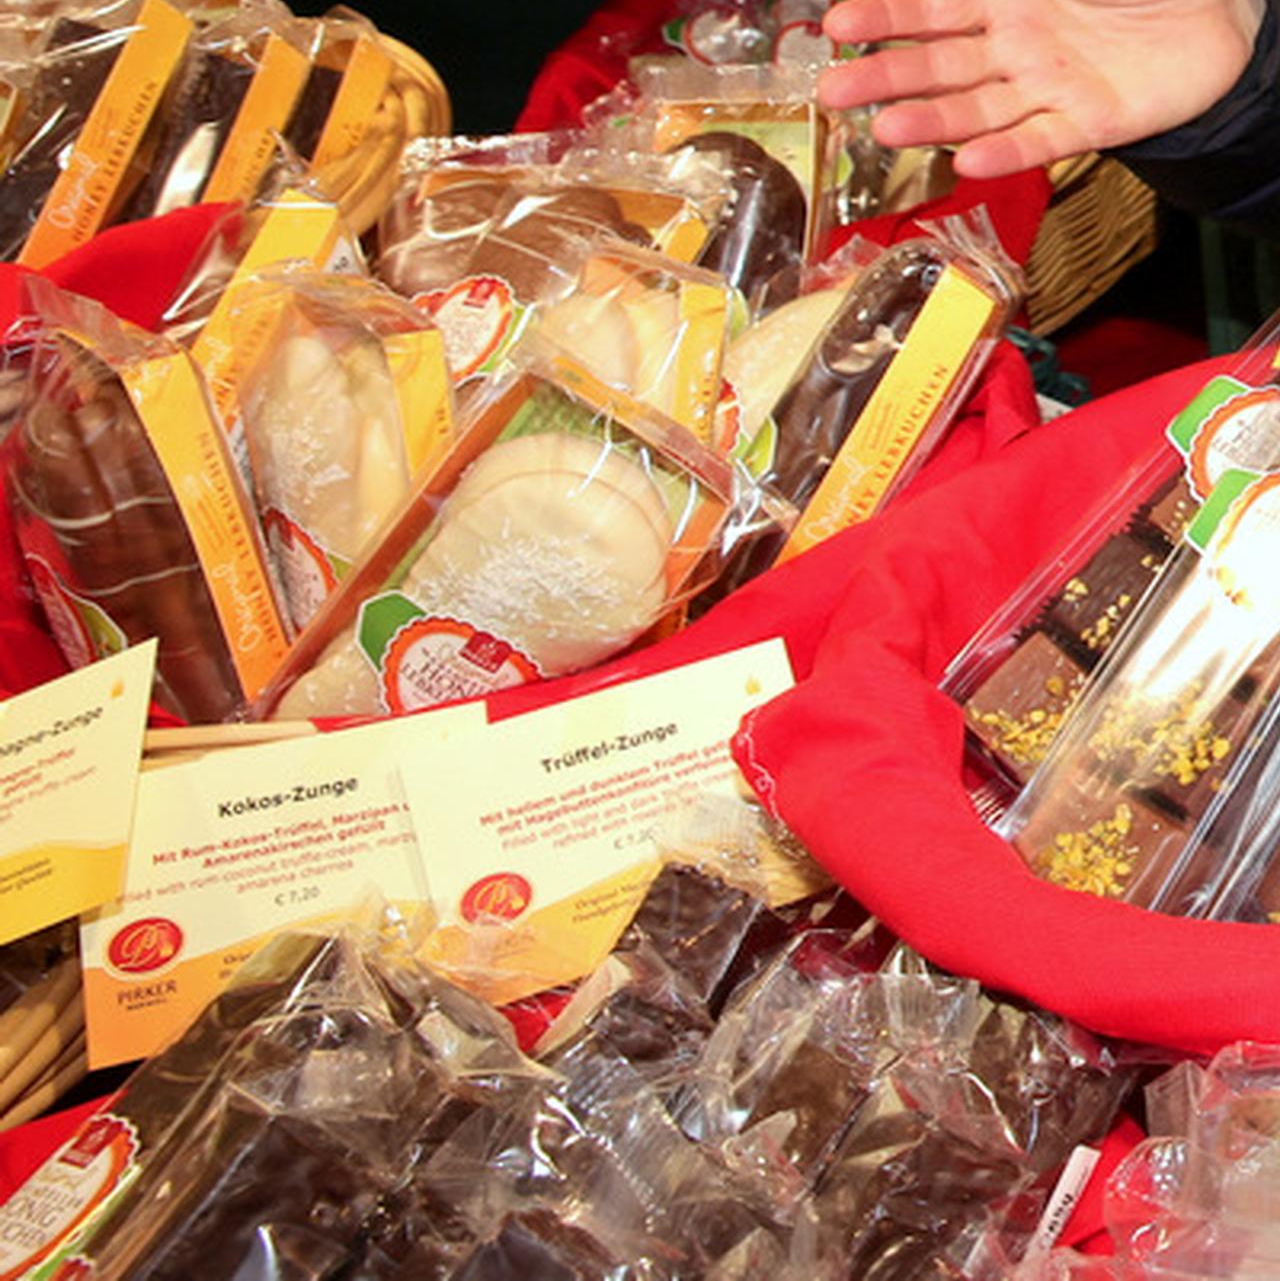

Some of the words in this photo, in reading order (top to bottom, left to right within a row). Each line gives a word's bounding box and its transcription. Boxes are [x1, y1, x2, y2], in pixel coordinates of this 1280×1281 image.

[873, 362, 949, 481] LEBKUCHEN
[541, 722, 680, 775] Trüffel-Zunge
[217, 772, 361, 824] Kokos-Zunge
[559, 785, 587, 802] und
[151, 850, 178, 866] Mit
[331, 801, 400, 828] Marzipan
[201, 829, 334, 871] Amarenakirschen
[273, 893, 287, 907] €
[117, 982, 178, 1005] PIRKER
